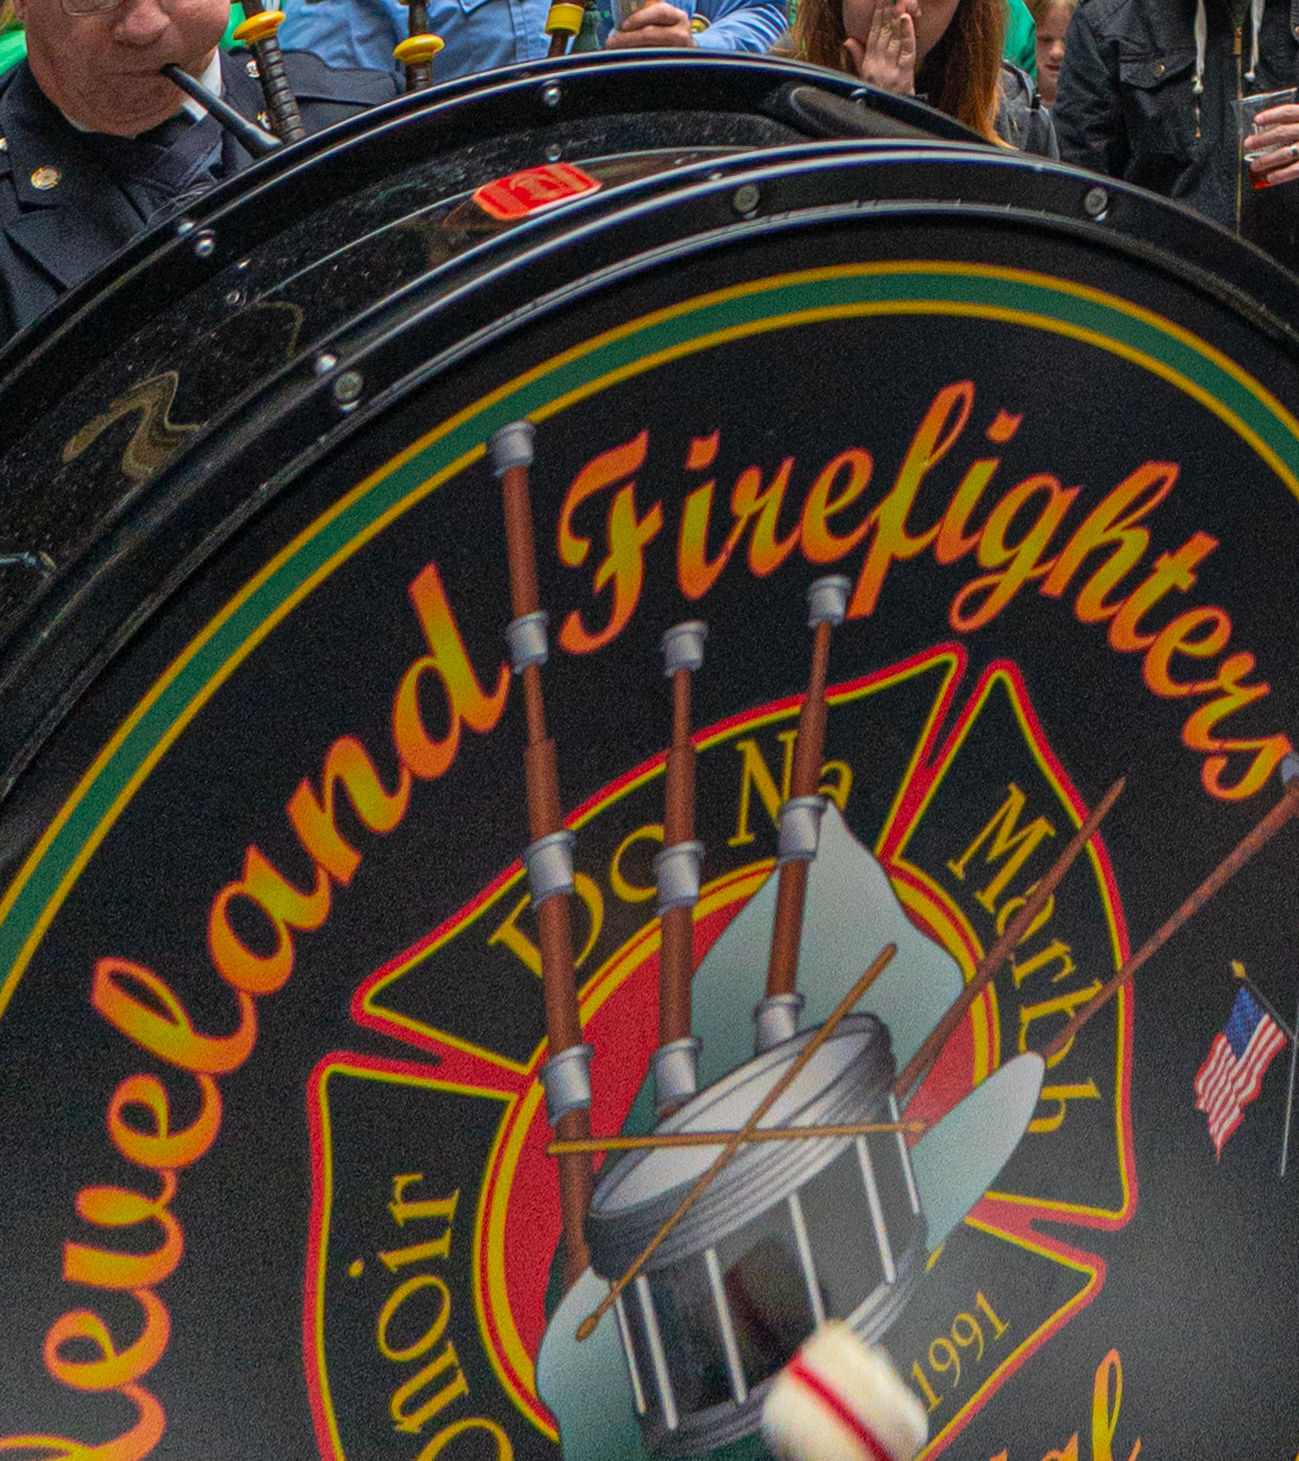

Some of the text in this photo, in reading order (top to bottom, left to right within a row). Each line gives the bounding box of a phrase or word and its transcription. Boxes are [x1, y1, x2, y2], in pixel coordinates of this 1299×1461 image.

[0, 380, 1292, 1461] leveland Firefighters
[911, 1290, 1011, 1413] 1991
